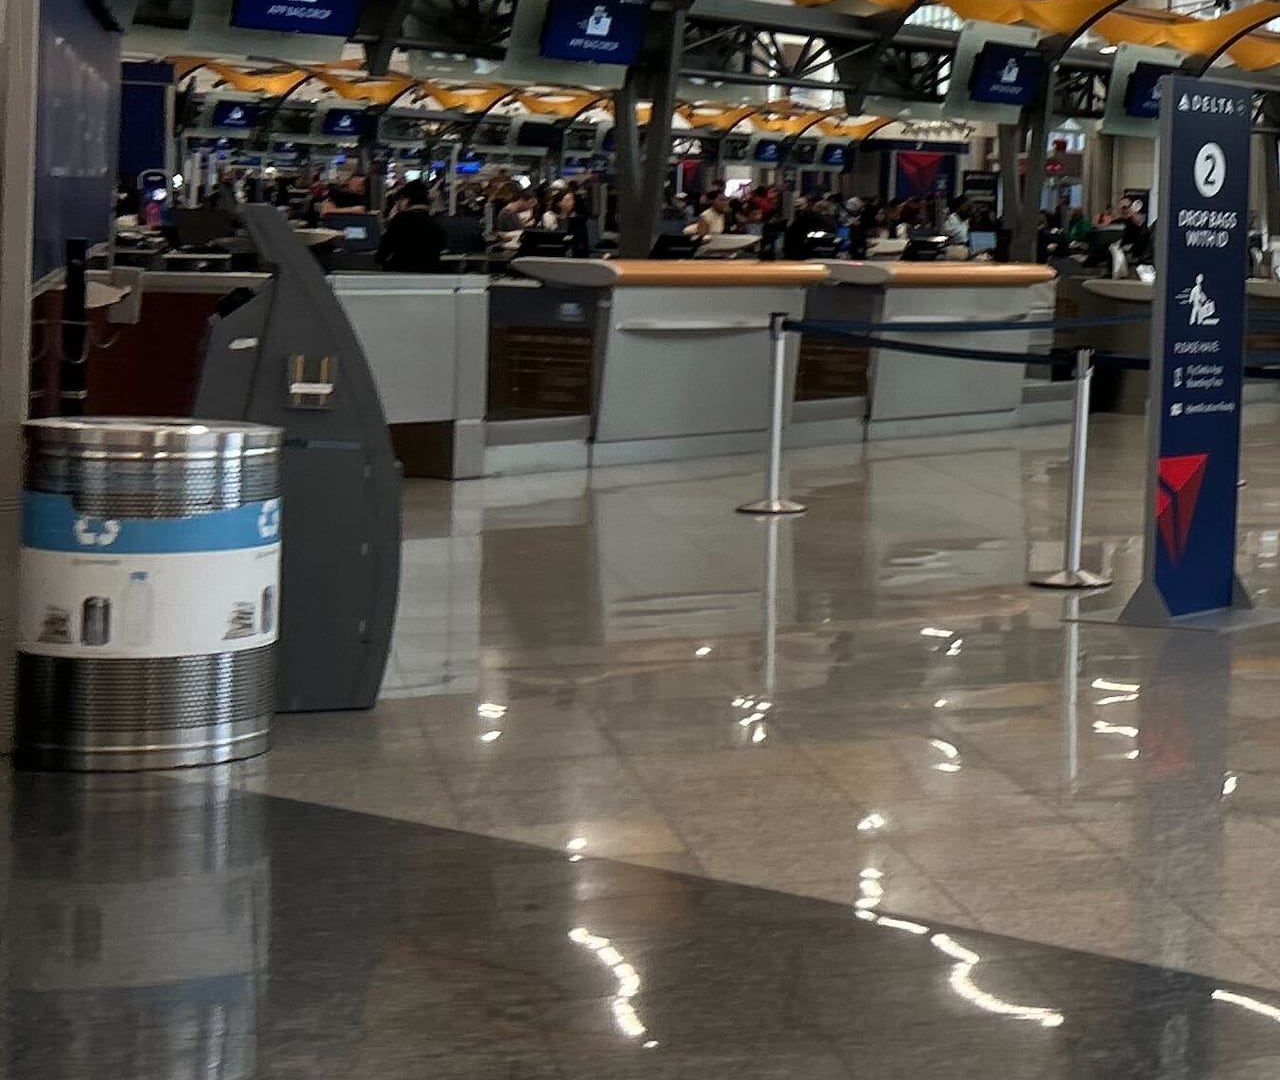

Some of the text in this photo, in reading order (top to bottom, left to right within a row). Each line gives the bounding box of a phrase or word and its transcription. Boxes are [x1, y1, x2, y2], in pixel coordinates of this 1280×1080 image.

[1191, 94, 1235, 115] DELTA
[1203, 154, 1217, 186] 2
[1178, 209, 1238, 230] DROP BAGS
[1185, 230, 1216, 248] WITH
